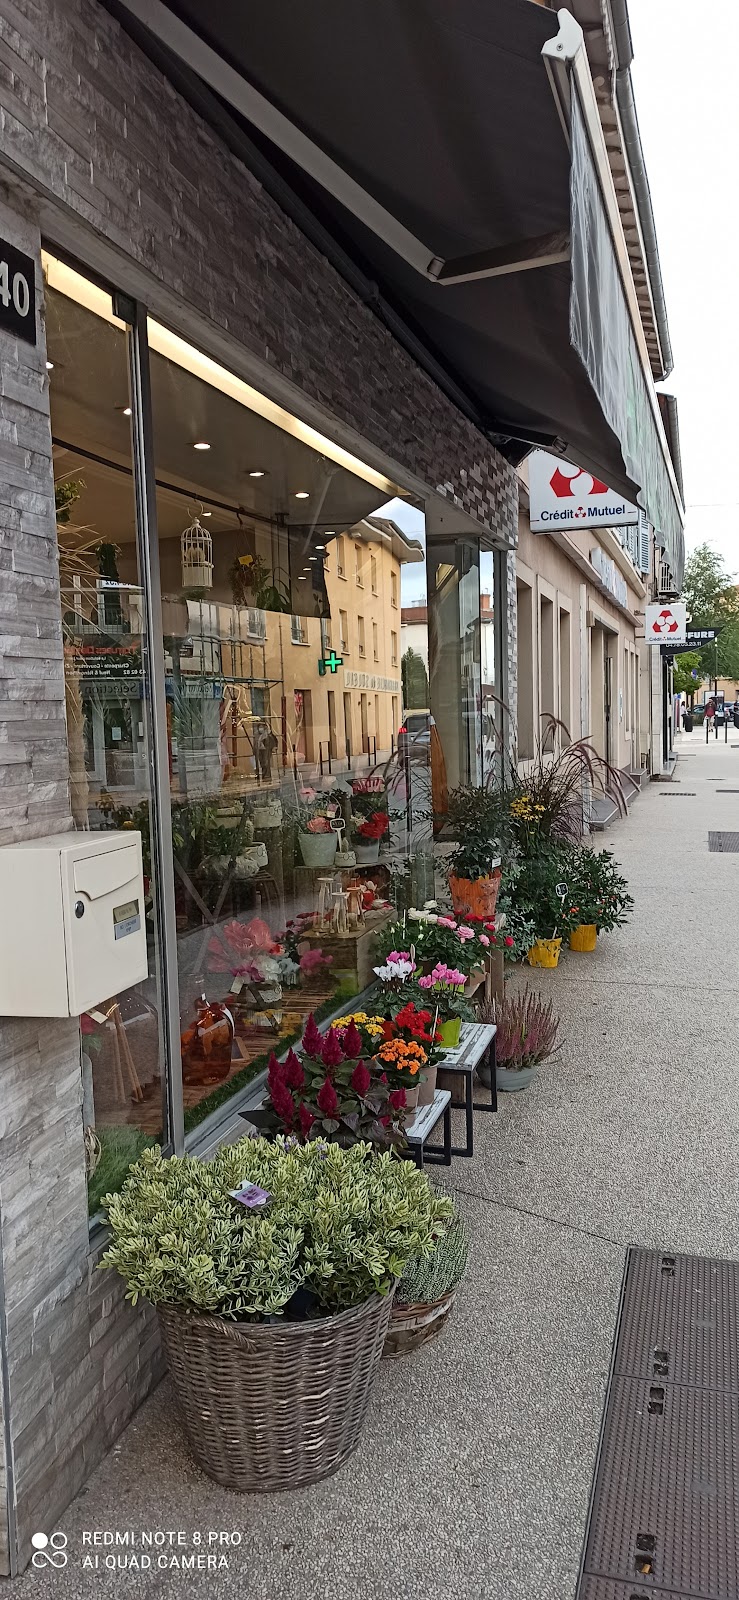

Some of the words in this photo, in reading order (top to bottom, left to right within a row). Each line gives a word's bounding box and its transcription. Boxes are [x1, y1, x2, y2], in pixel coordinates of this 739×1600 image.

[540, 509, 574, 521] Crédit
[587, 504, 626, 517] Mutuel
[685, 630, 715, 639] FURE
